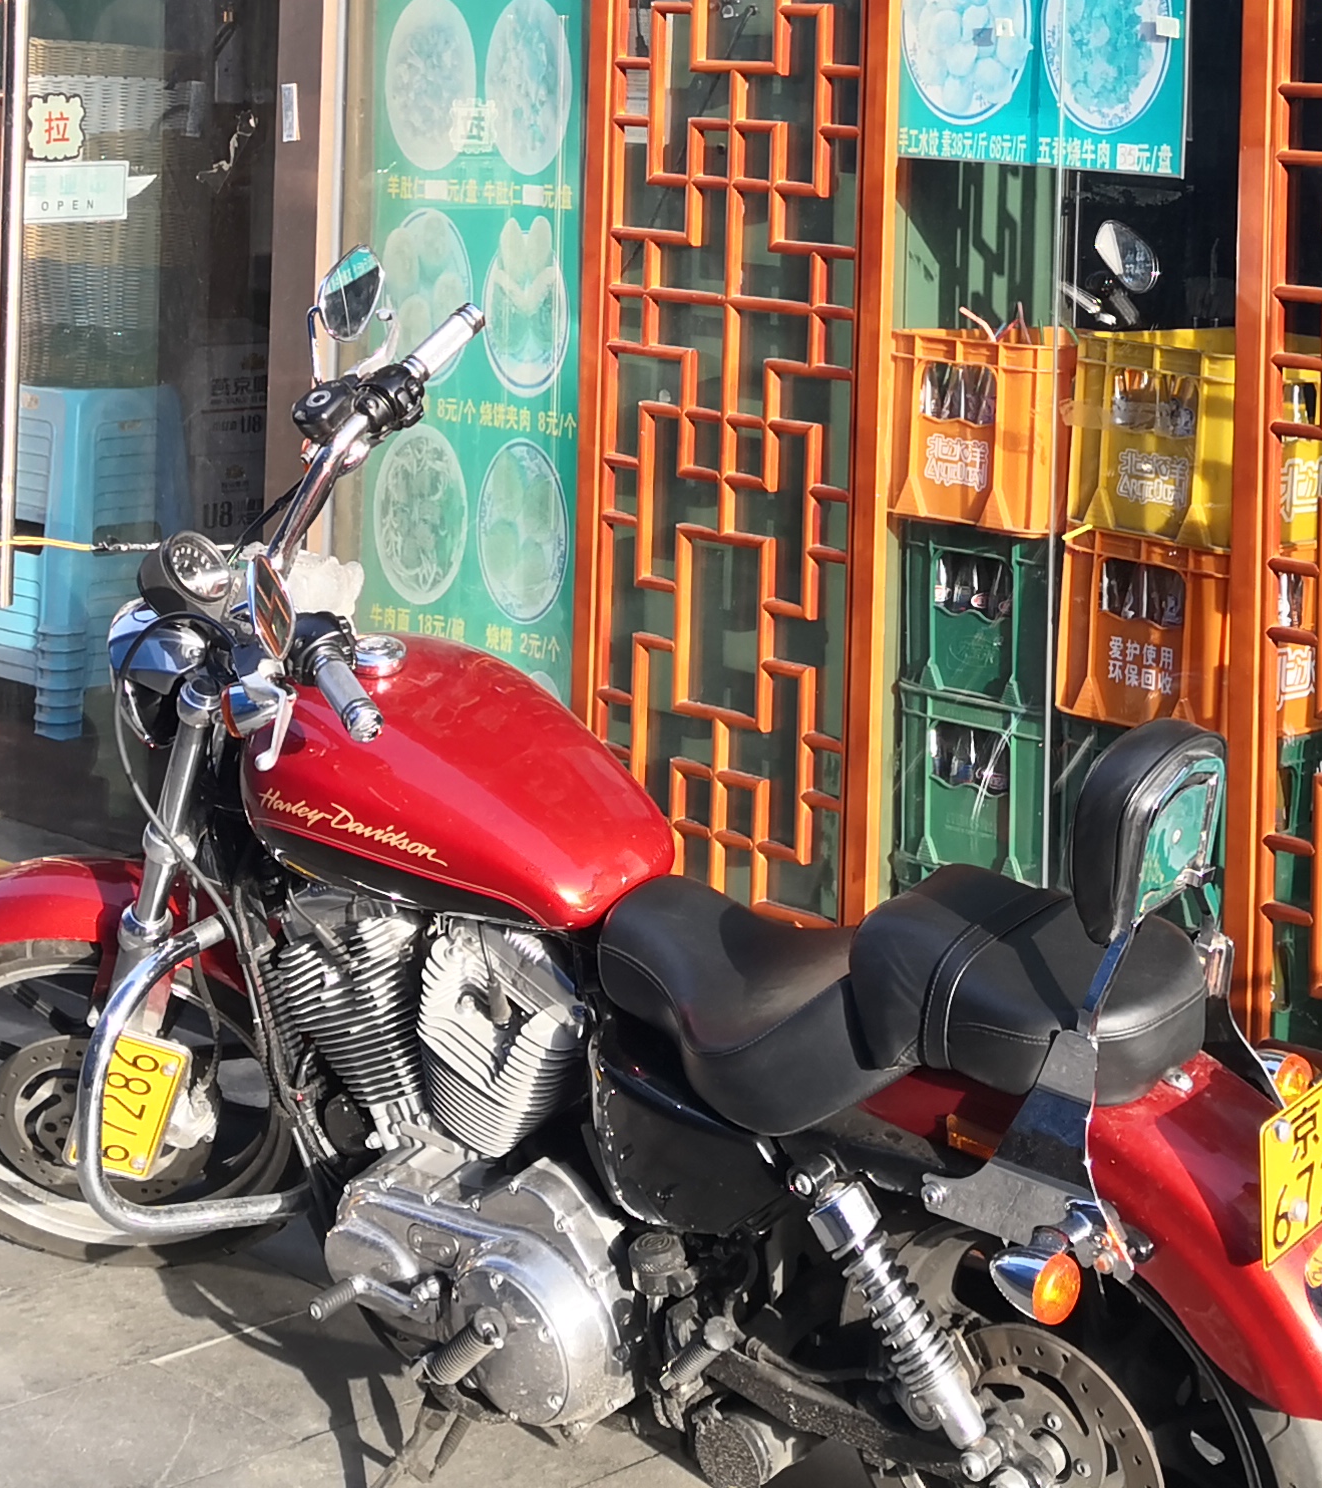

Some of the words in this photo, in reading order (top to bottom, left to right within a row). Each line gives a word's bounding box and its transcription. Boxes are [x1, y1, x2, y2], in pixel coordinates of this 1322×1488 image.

[44, 110, 70, 144] 拉
[898, 126, 939, 157] 手工水饺
[989, 134, 1027, 163] 68元/斤
[1037, 136, 1110, 170] 五香烧牛肉
[388, 174, 425, 200] 羊肚仁
[484, 179, 522, 206] 牛肚仁
[40, 198, 95, 213] OPEN
[437, 397, 476, 424] 8元/个
[479, 400, 531, 432] 烧饼夹肉
[538, 411, 577, 440] 8元/个
[203, 501, 233, 529] U8
[369, 602, 411, 632] 牛肉面
[484, 623, 514, 654] 烧饼
[520, 632, 561, 663] 2元/个
[1108, 635, 1173, 671] 爱护使用
[1107, 659, 1173, 695] 环保回收
[259, 787, 448, 867] Harley-Davidson
